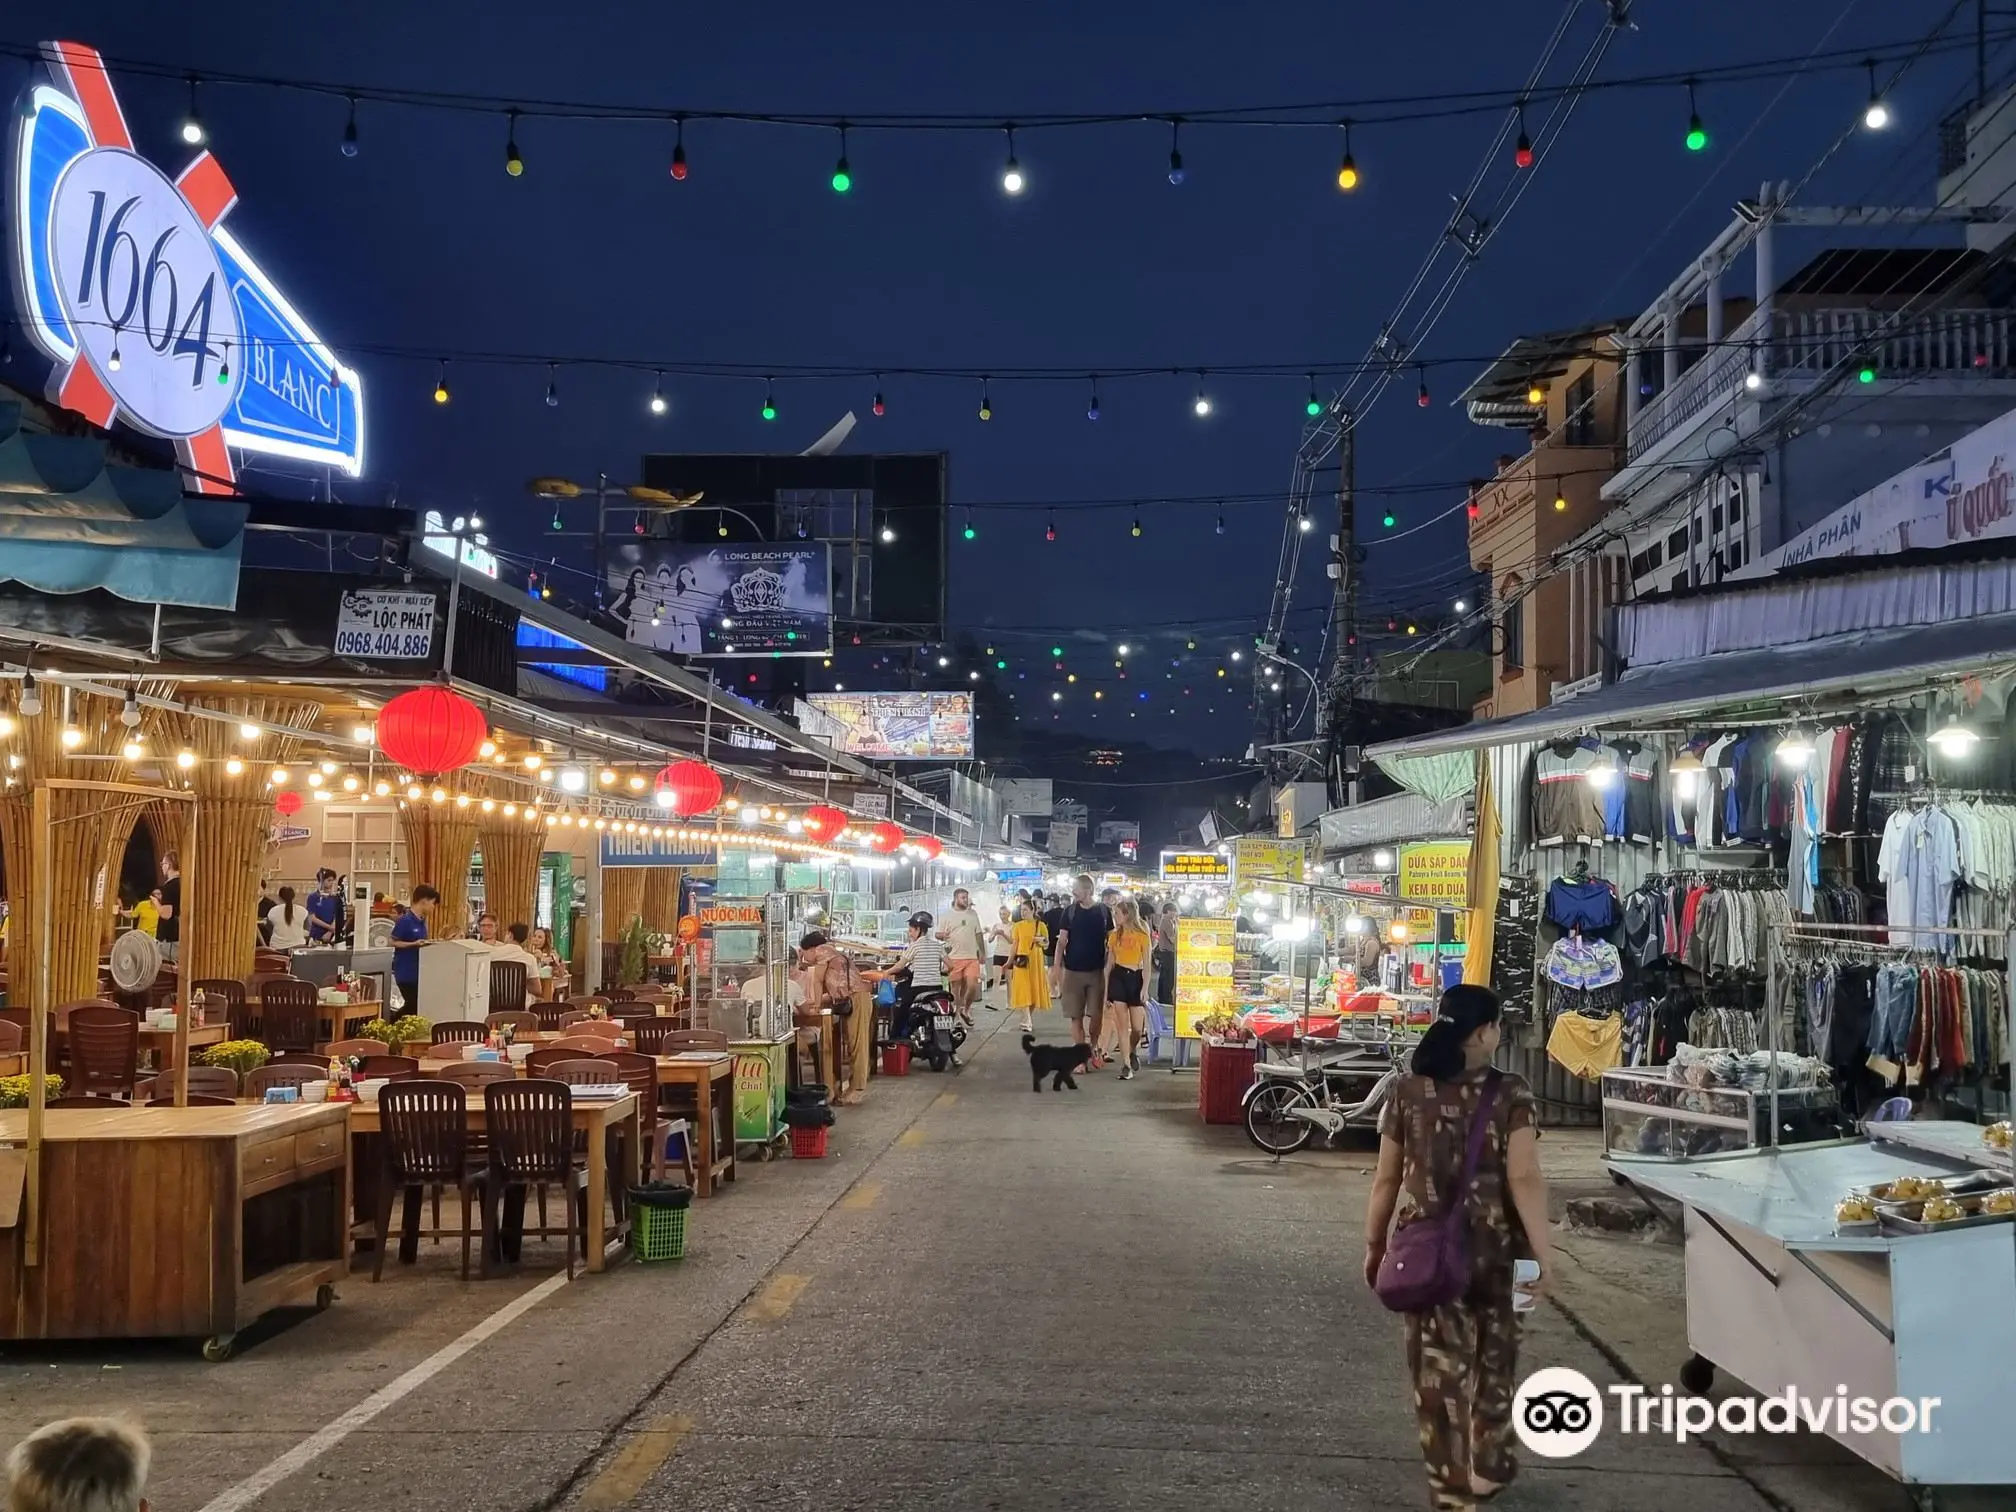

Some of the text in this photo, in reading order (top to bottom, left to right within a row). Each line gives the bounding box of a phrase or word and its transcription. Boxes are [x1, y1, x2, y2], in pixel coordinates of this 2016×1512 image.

[77, 190, 221, 388] 1664
[253, 335, 332, 430] BLANC
[1818, 511, 1862, 550] PHÂN
[724, 550, 812, 560] LONG BEACH PEARL
[373, 606, 432, 632] LỘC PHÁT
[337, 631, 430, 657] 0968.404.886
[1408, 883, 1428, 896] KEM
[1408, 908, 1429, 921] KEM
